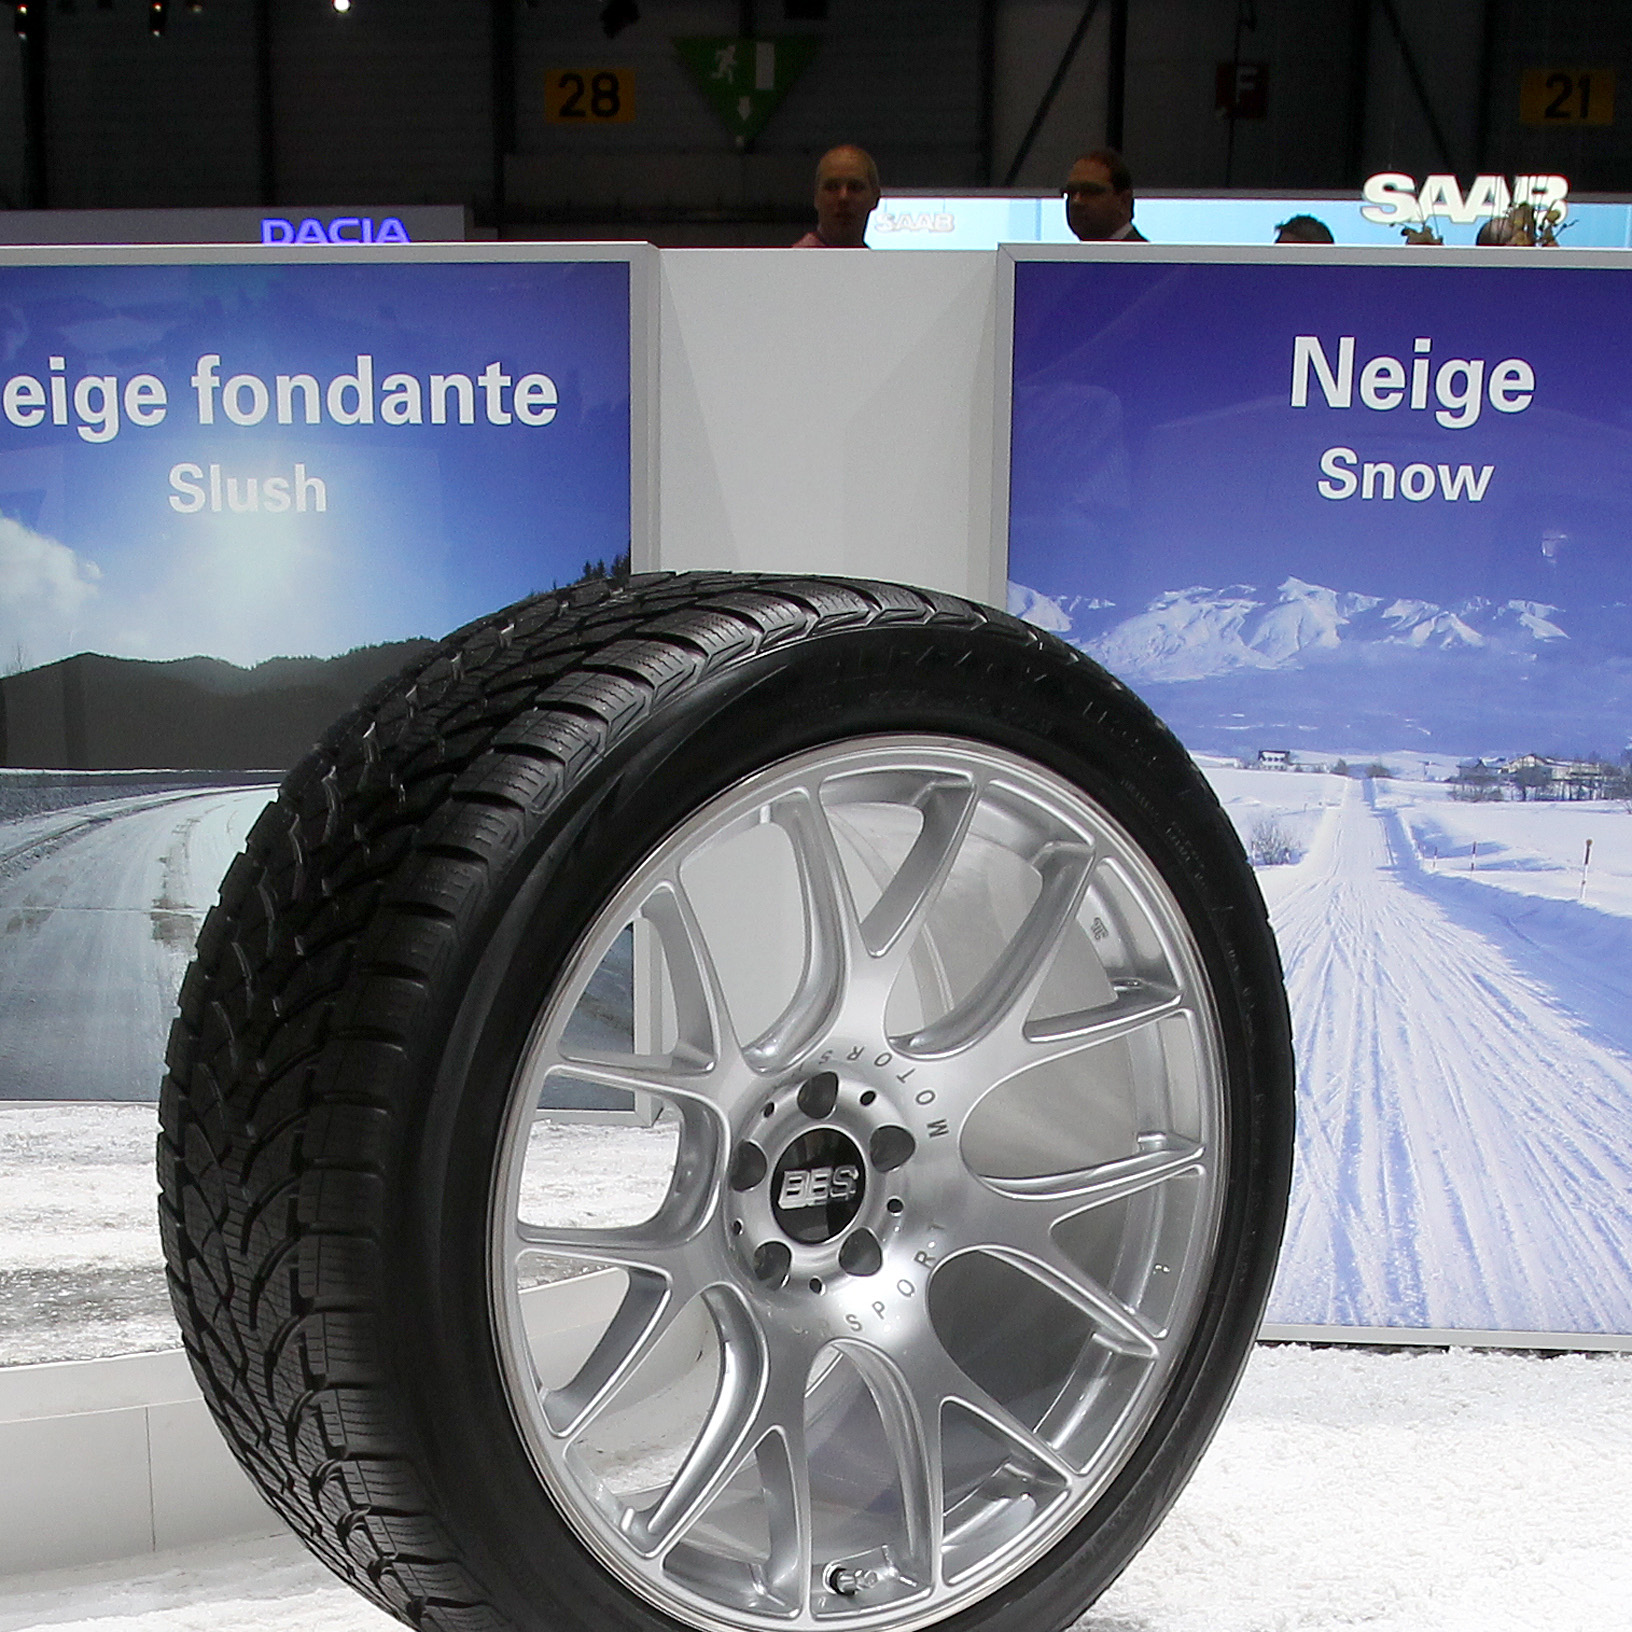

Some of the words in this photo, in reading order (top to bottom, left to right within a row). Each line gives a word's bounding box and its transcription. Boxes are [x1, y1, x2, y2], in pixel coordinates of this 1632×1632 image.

[558, 72, 620, 118] 28
[1545, 73, 1591, 118] 21
[874, 213, 955, 233] SAAB
[1361, 172, 1571, 225] SAAB
[261, 217, 411, 245] DACIA
[191, 354, 560, 428] fondante
[1290, 335, 1537, 430] Neige
[168, 463, 327, 514] Slush
[1317, 446, 1496, 503] Snow
